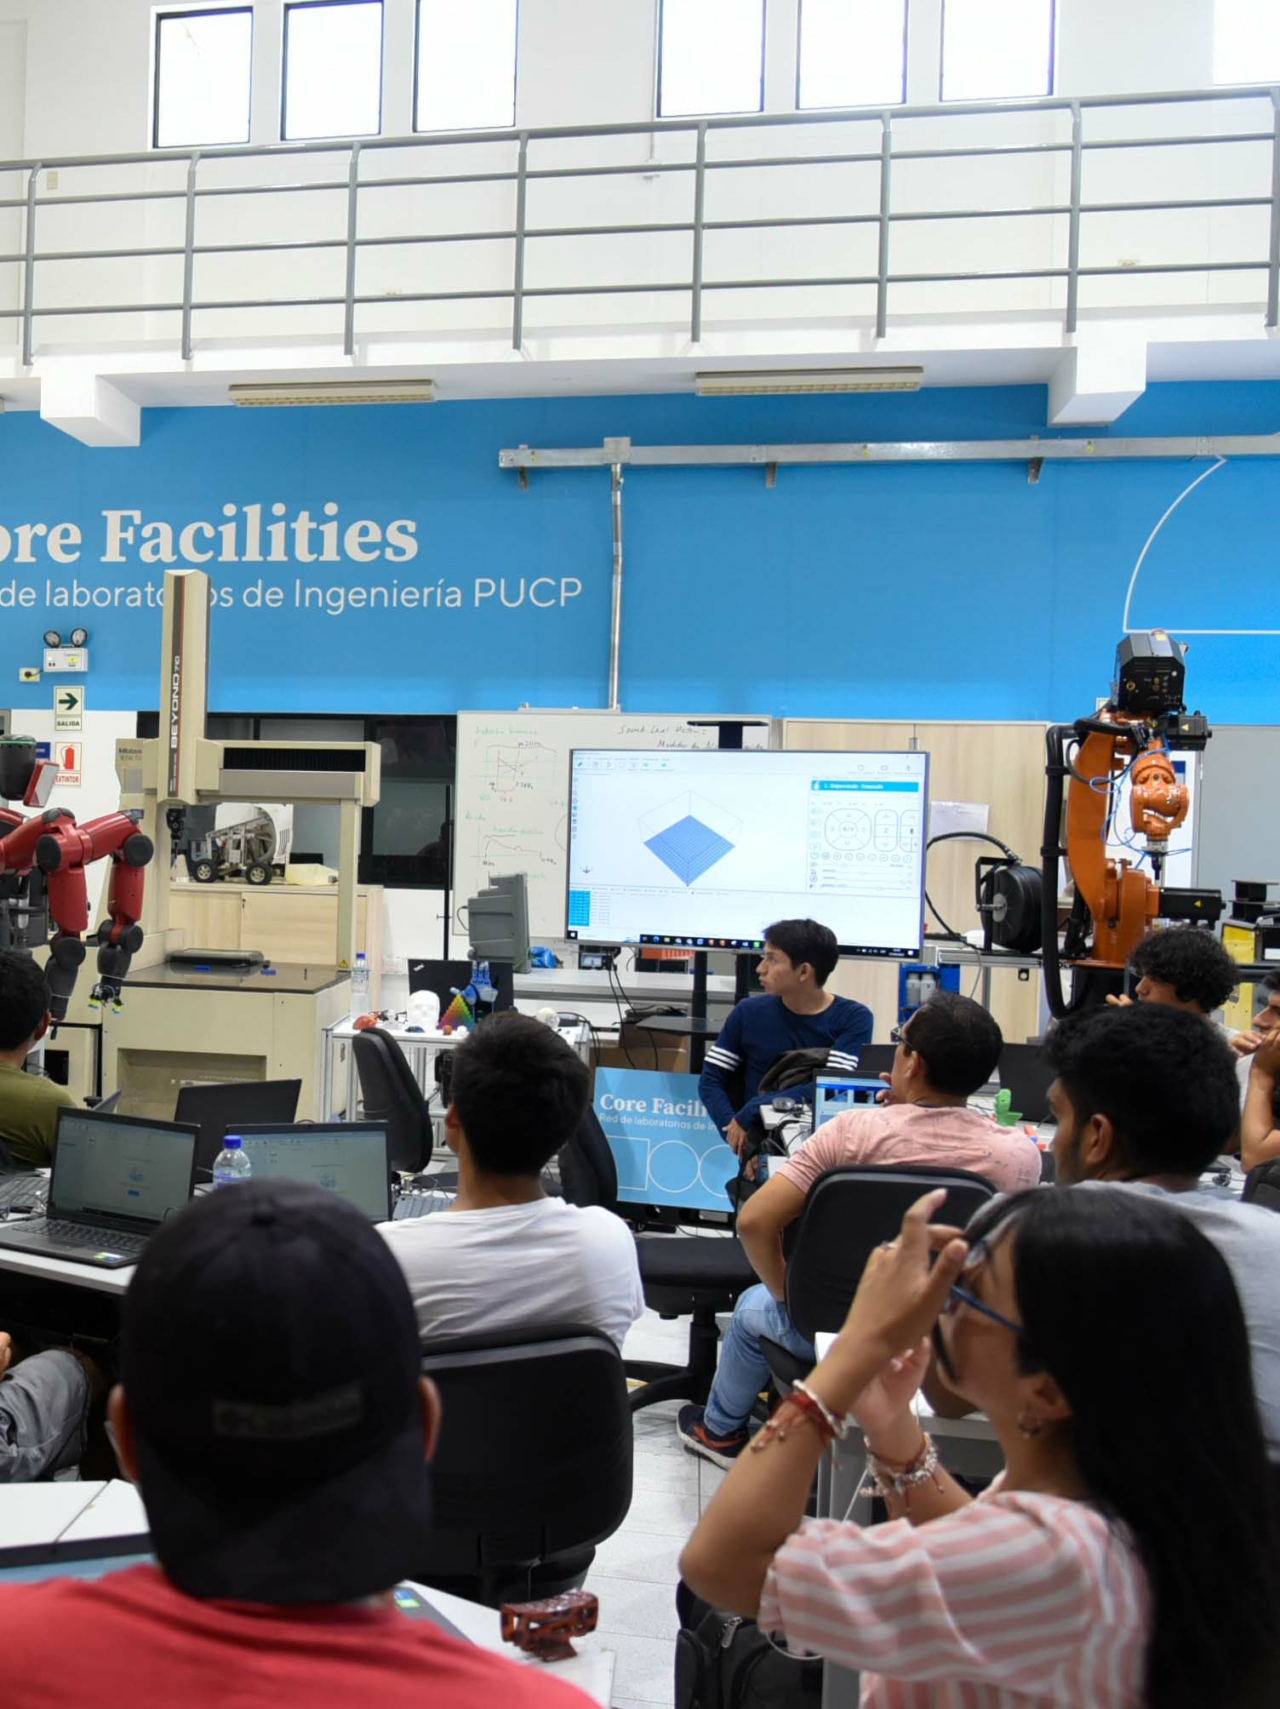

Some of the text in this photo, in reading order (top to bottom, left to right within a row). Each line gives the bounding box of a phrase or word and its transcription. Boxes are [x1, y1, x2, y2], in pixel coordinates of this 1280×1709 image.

[100, 502, 419, 564] Facilities
[46, 579, 234, 608] laborats
[242, 579, 285, 608] de
[295, 578, 462, 616] Ingeniería
[474, 577, 583, 608] PUCP
[170, 673, 180, 749] BEYOND
[600, 1093, 708, 1117] Core Facili
[600, 1113, 618, 1123] Red
[620, 1114, 632, 1124] de
[634, 1116, 691, 1129] laboratorios
[693, 1121, 706, 1131] de
